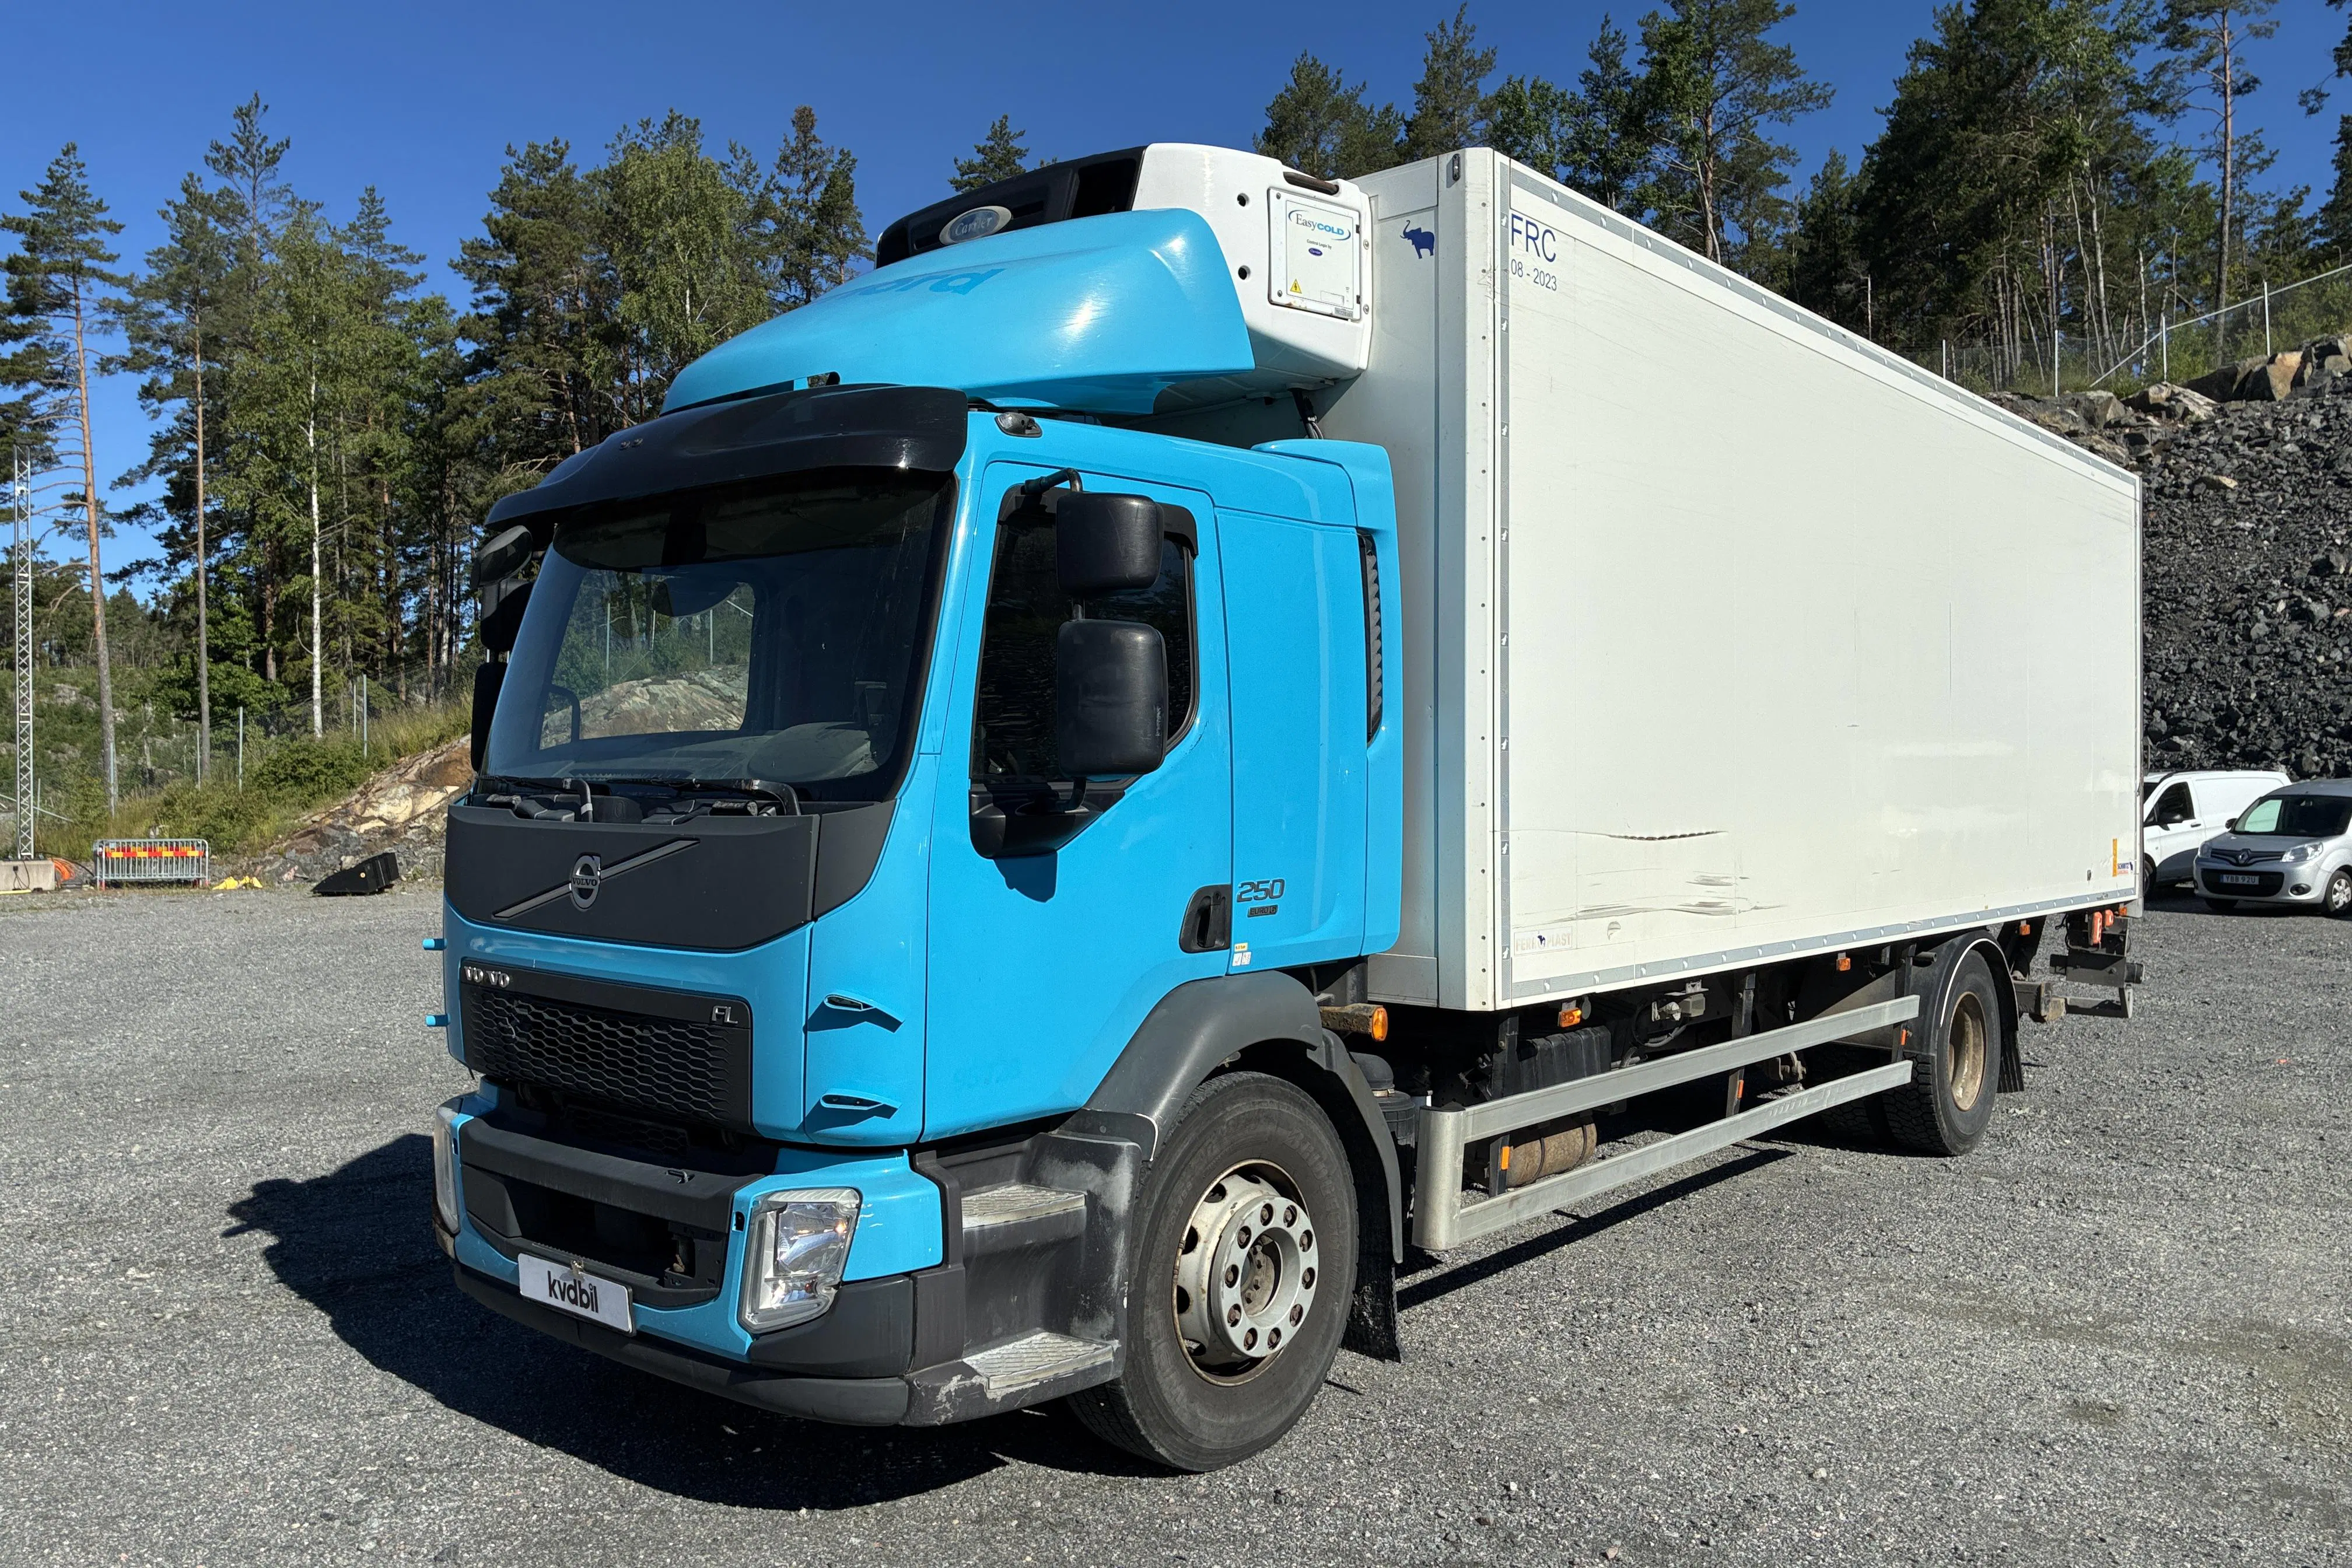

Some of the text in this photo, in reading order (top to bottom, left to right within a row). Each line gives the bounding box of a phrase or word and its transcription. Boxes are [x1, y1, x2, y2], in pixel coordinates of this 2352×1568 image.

[955, 217, 992, 236] Carrier
[1296, 213, 1345, 235] EasyCOLD
[1511, 214, 1556, 262] FRC
[1511, 258, 1523, 278] 08
[1533, 268, 1557, 291] 2023
[572, 877, 597, 886] VOLVO
[1236, 878, 1285, 903] 250
[1250, 907, 1269, 915] EURO
[464, 966, 510, 988] VOVO
[712, 1005, 738, 1024] FL
[547, 1270, 599, 1314] kvdbil
